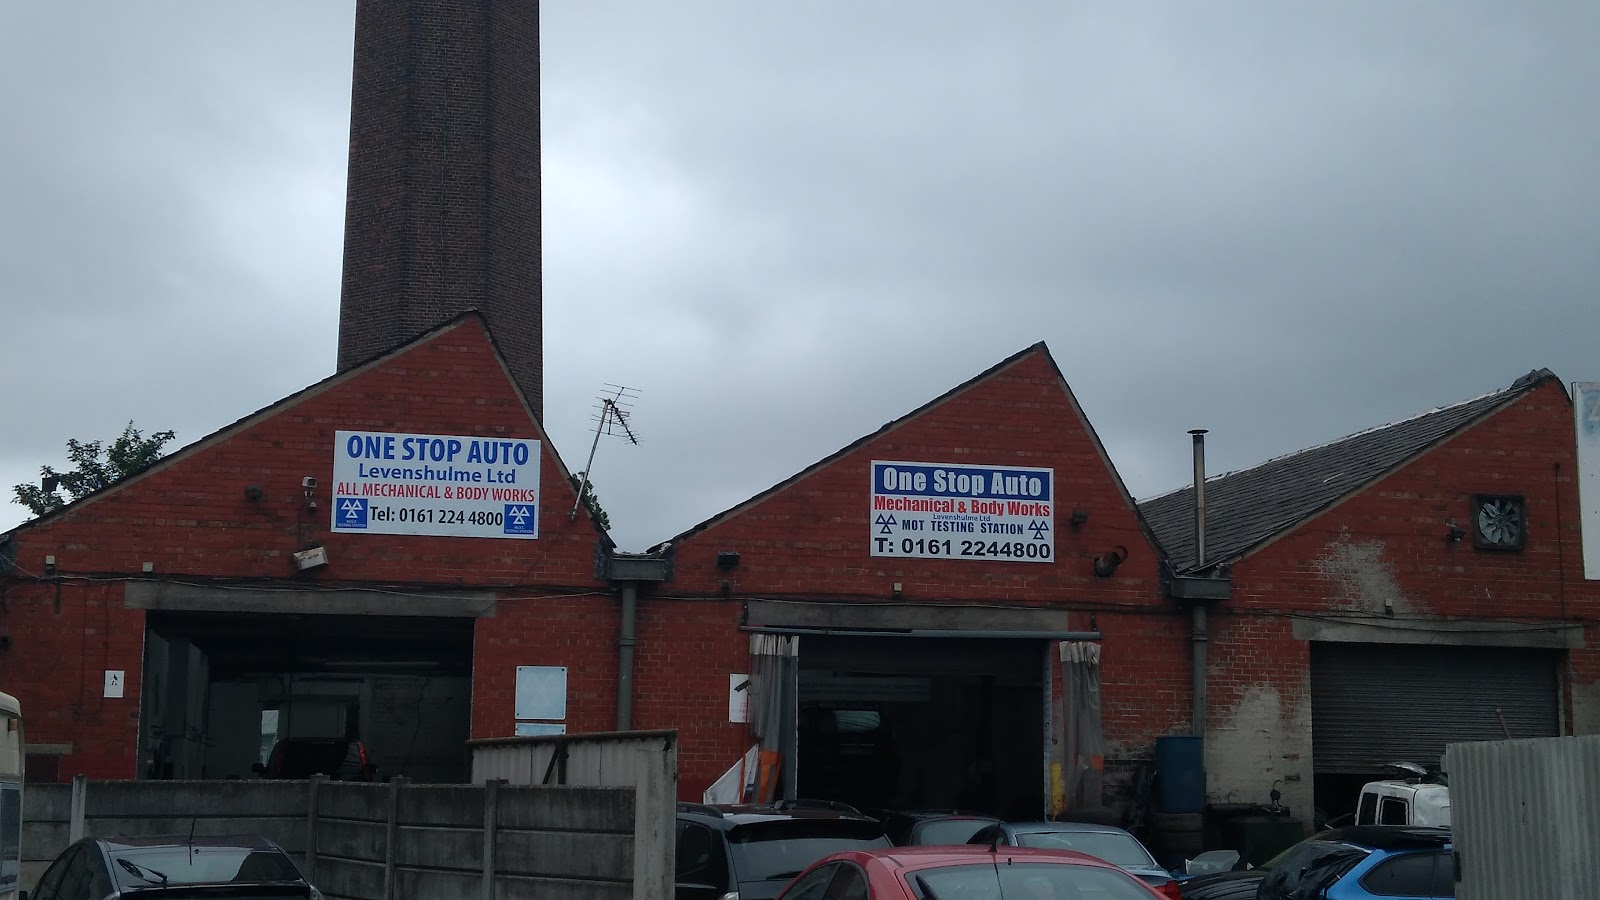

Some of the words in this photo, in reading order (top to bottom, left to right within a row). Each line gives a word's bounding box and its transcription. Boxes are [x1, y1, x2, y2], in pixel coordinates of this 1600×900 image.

[347, 435, 396, 460] ONE
[402, 438, 461, 462] STOP
[467, 441, 529, 465] AUTO
[359, 463, 482, 482] Levenshulme
[487, 469, 516, 483] Ltd
[883, 467, 926, 492] One
[934, 469, 984, 496] Stop
[991, 472, 1041, 496] Auto
[337, 482, 360, 496] ALL
[362, 482, 440, 499] MECHANICAL
[444, 487, 453, 499] &
[457, 487, 489, 500] BODY
[492, 488, 534, 502] WORKS
[370, 506, 395, 522] Tel:
[400, 508, 433, 524] 0161
[874, 496, 954, 512] Mechanical
[958, 501, 967, 513] &
[972, 500, 1004, 517] Body
[1008, 502, 1050, 517] Works
[902, 520, 924, 531] MOT
[931, 520, 974, 533] TESTING
[980, 523, 1023, 534] STATION
[875, 538, 893, 552] T:
[902, 539, 951, 555] 0161
[961, 541, 1050, 558] 2244800
